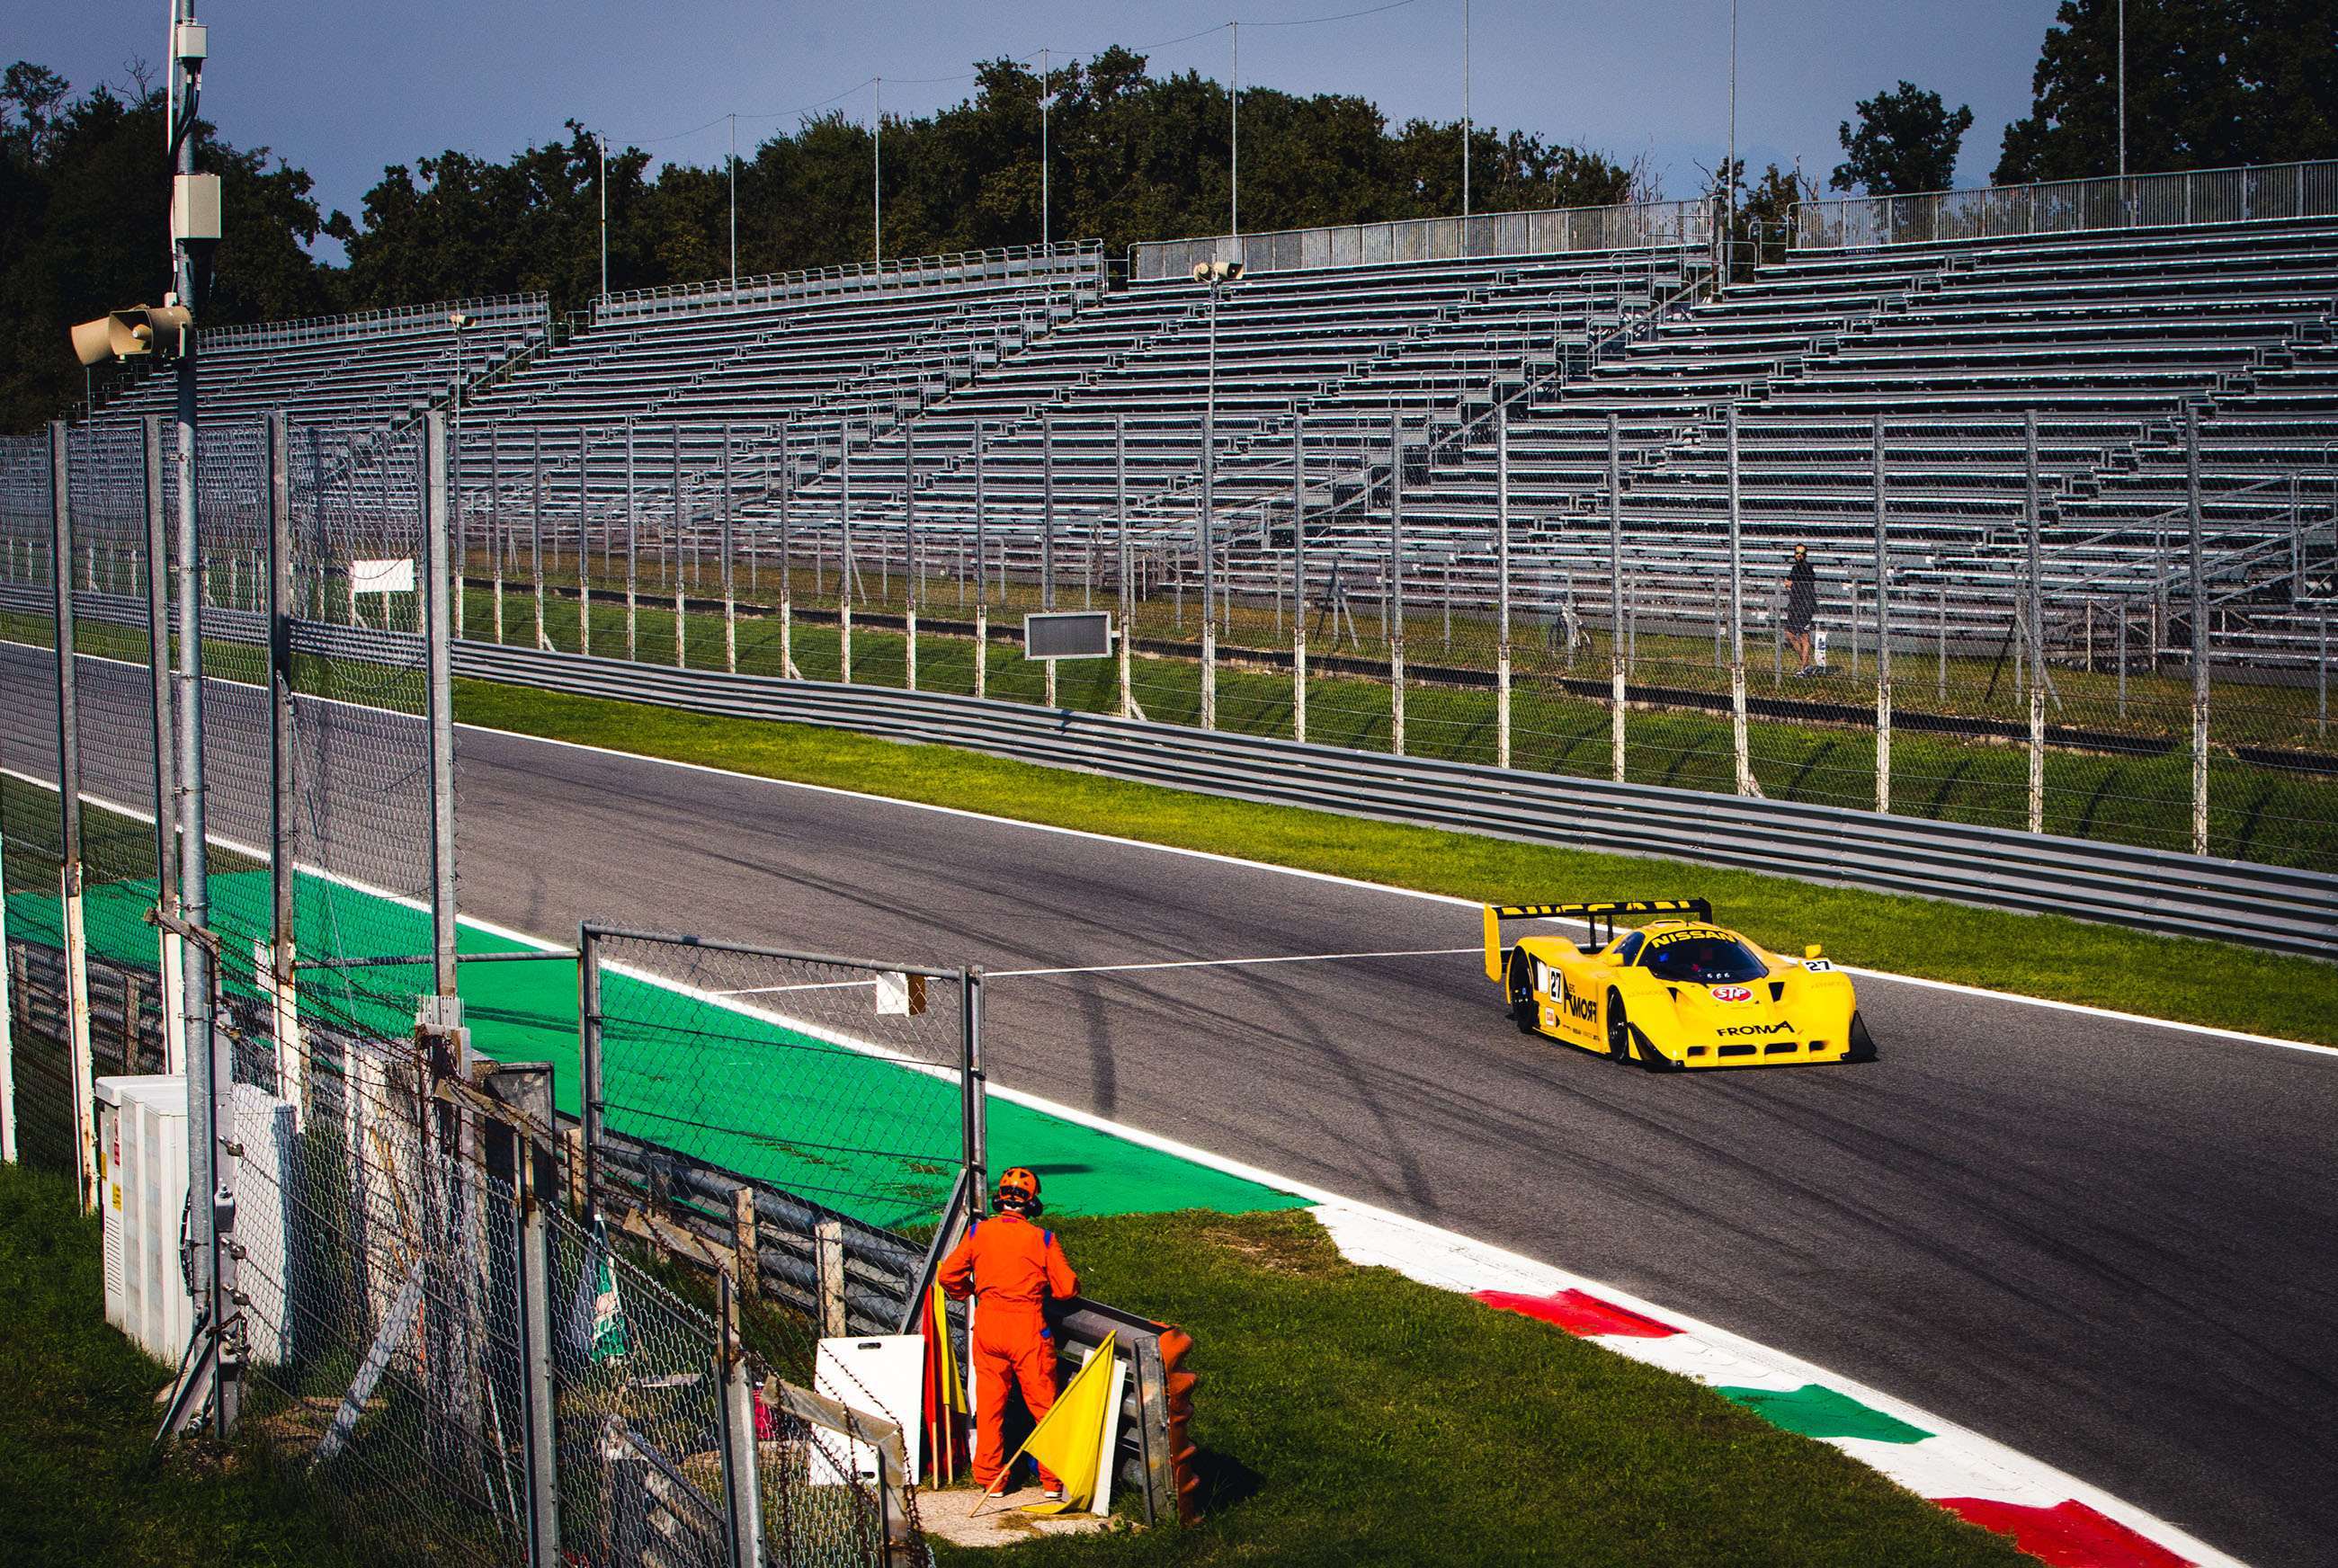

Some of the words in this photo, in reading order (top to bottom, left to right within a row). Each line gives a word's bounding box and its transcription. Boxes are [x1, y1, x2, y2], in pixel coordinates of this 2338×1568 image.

[1651, 931, 1737, 949] NISSAN
[1806, 961, 1830, 971] 27
[1550, 970, 1561, 1000] 27
[1718, 987, 1746, 999] STP
[1717, 1020, 1795, 1037] FROMA
